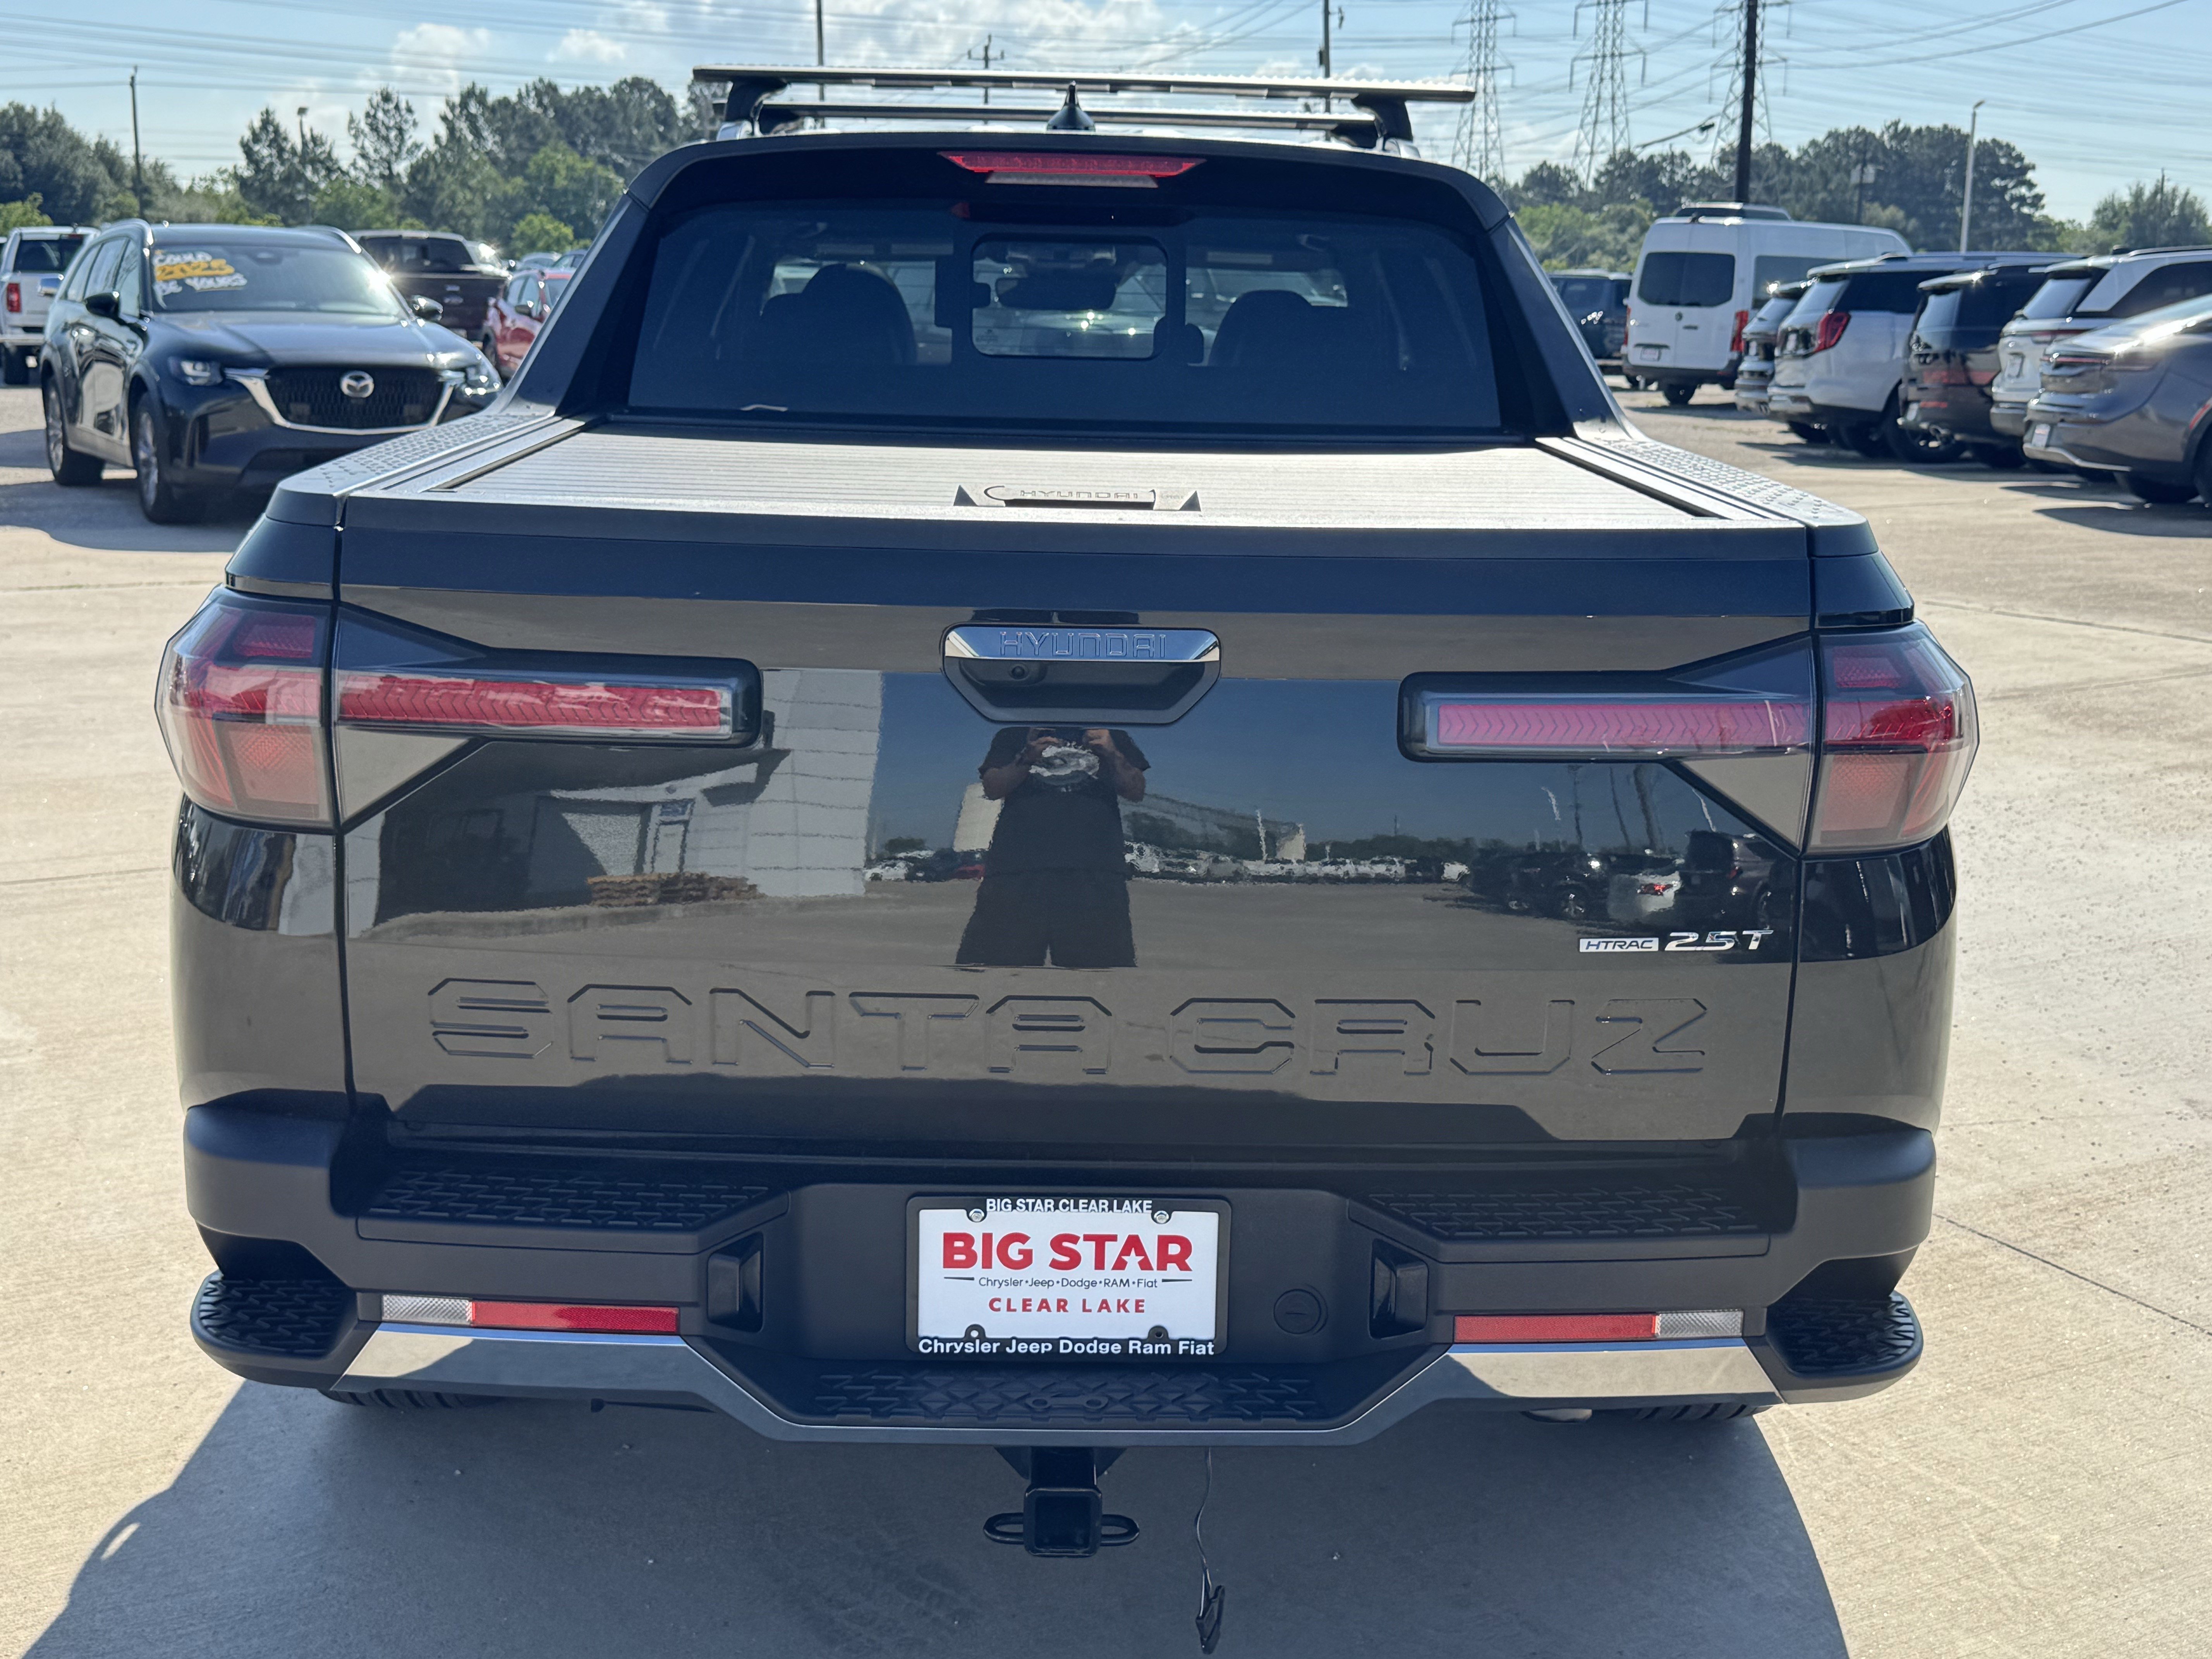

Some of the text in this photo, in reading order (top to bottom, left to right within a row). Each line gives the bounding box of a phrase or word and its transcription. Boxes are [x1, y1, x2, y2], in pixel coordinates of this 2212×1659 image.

[1020, 489, 1138, 499] HYUNDAI
[999, 631, 1166, 658] HYUNDAI
[1585, 939, 1654, 950] HTRAC
[427, 977, 1709, 1076] SANTA CRUZ
[986, 1198, 1152, 1213] BIG STAR CLEAR LAKE
[943, 1232, 1193, 1271] BIG STAR
[978, 1277, 1158, 1290] Chrysler Jeep Dodge RAM Fiat
[988, 1297, 1145, 1313] CLEAR LAKE
[918, 1339, 1215, 1355] Chrysler Jeep Dodge Ram Fiat
